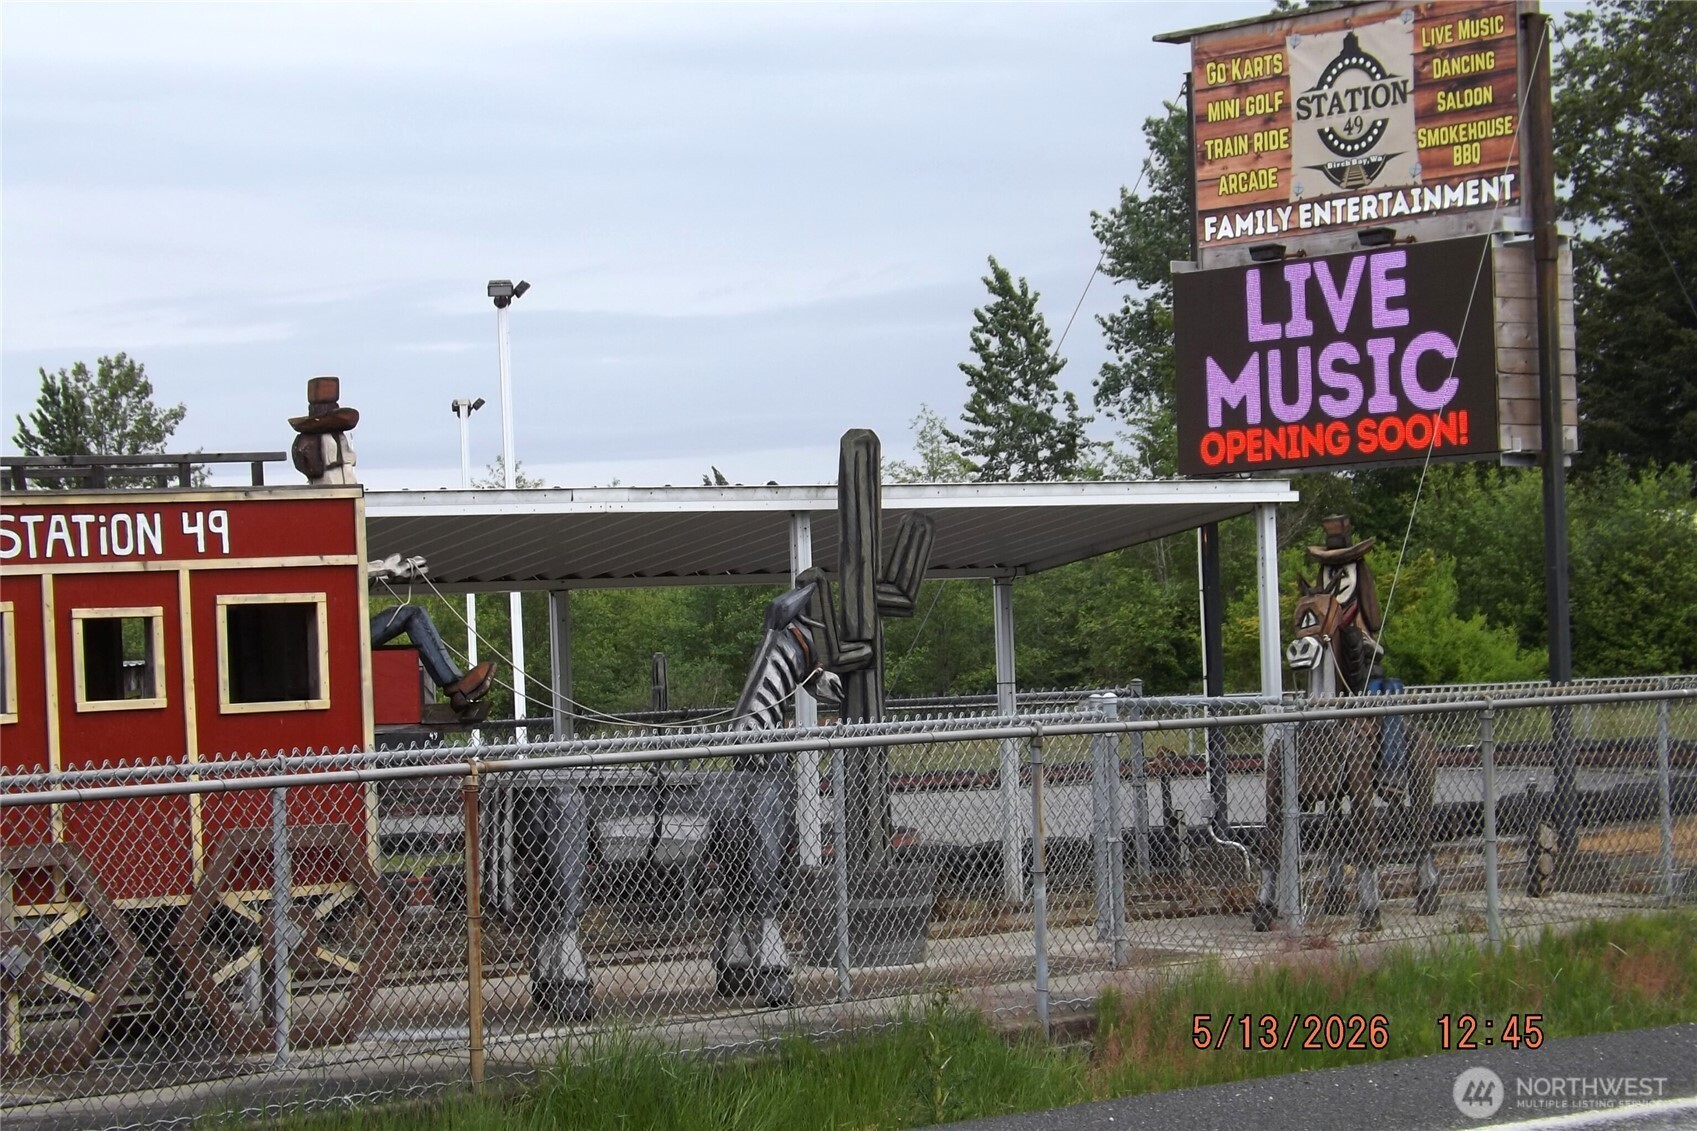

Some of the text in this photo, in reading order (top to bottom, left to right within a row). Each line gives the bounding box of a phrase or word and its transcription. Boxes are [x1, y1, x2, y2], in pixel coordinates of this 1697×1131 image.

[1421, 14, 1504, 48] LIVE MUSIC
[1231, 52, 1283, 82] KARTS
[1432, 51, 1495, 79] DANCING
[1207, 91, 1284, 123] MINI GOLF
[1296, 79, 1409, 120] STATION
[1436, 85, 1493, 112] SALOON
[1343, 115, 1363, 136] 49
[1417, 115, 1514, 149] SMOKEHOUSE
[1204, 128, 1290, 160] TRAIN RIDE
[1453, 142, 1481, 166] BBQ
[1327, 160, 1351, 169] Birch
[1218, 167, 1278, 196] ARCADE
[1203, 173, 1515, 242] FAMILY ENTERTAINMENT
[1246, 250, 1410, 343] LIVE
[1205, 330, 1460, 428] MUSIC
[1200, 409, 1470, 467] OPENING SOON!
[182, 509, 230, 554] 49
